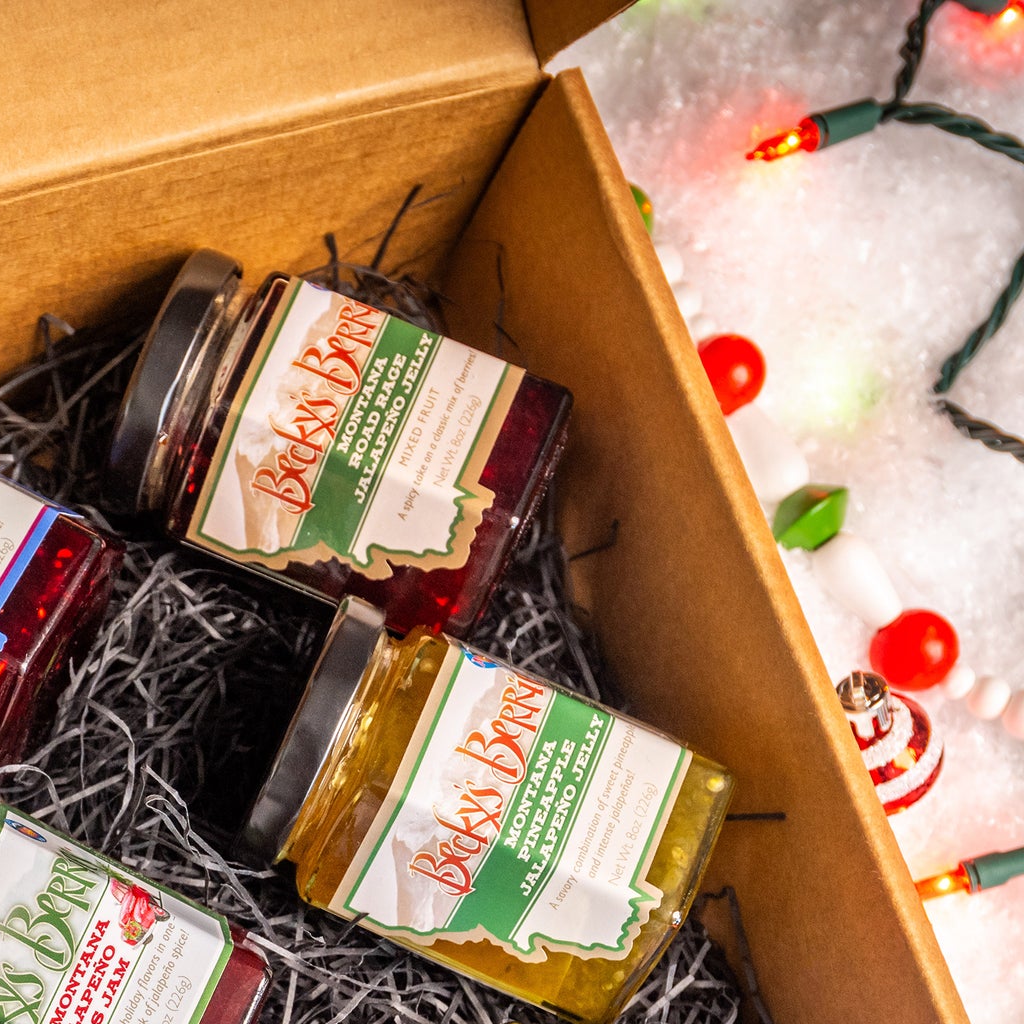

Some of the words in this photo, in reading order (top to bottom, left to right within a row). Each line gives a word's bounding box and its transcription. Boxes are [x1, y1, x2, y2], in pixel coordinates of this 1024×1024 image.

[249, 389, 338, 515] Becky's
[335, 356, 388, 454] MONTANA
[347, 408, 382, 469] ROAD
[374, 352, 407, 409] RAGE
[352, 394, 407, 504] JALAPEÑO
[400, 331, 434, 394] JELLY
[398, 425, 424, 467] MIXED
[419, 385, 440, 424] FRUIT
[407, 778, 504, 896] Becky's
[503, 739, 557, 849] MONTANA
[516, 737, 576, 862] PINEAPPLE
[517, 782, 580, 897] JALAPEÑO
[570, 712, 605, 782] JELLY
[585, 856, 602, 879] and
[595, 820, 617, 858] intense
[612, 769, 638, 823] jalapeños!
[98, 956, 130, 1008] JAM
[136, 953, 161, 990] flavors
[155, 941, 166, 953] in
[161, 921, 176, 942] one
